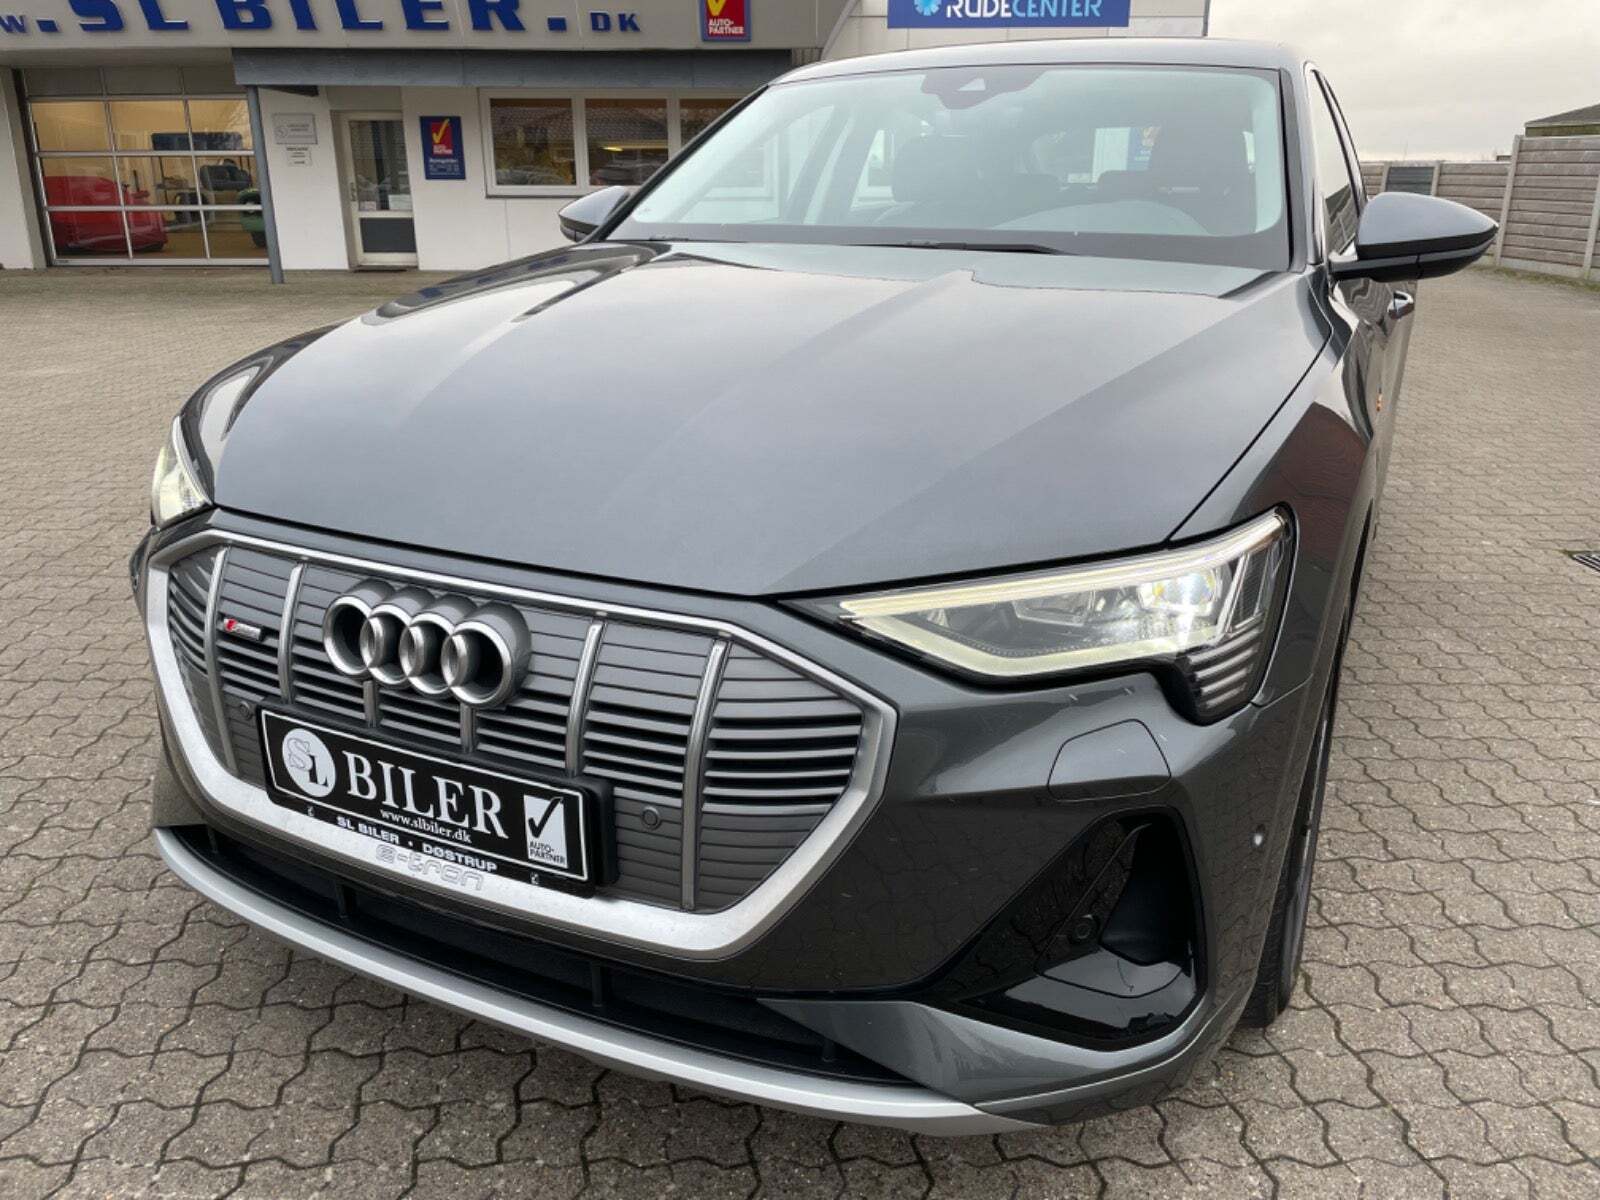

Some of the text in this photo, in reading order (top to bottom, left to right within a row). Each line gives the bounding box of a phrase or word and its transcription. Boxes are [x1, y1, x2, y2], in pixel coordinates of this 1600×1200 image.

[342, 750, 509, 840] BILER
[336, 815, 355, 830] SL
[358, 823, 400, 845] BILER
[380, 808, 473, 844] www.slbiler.dk
[376, 843, 484, 891] e-tron
